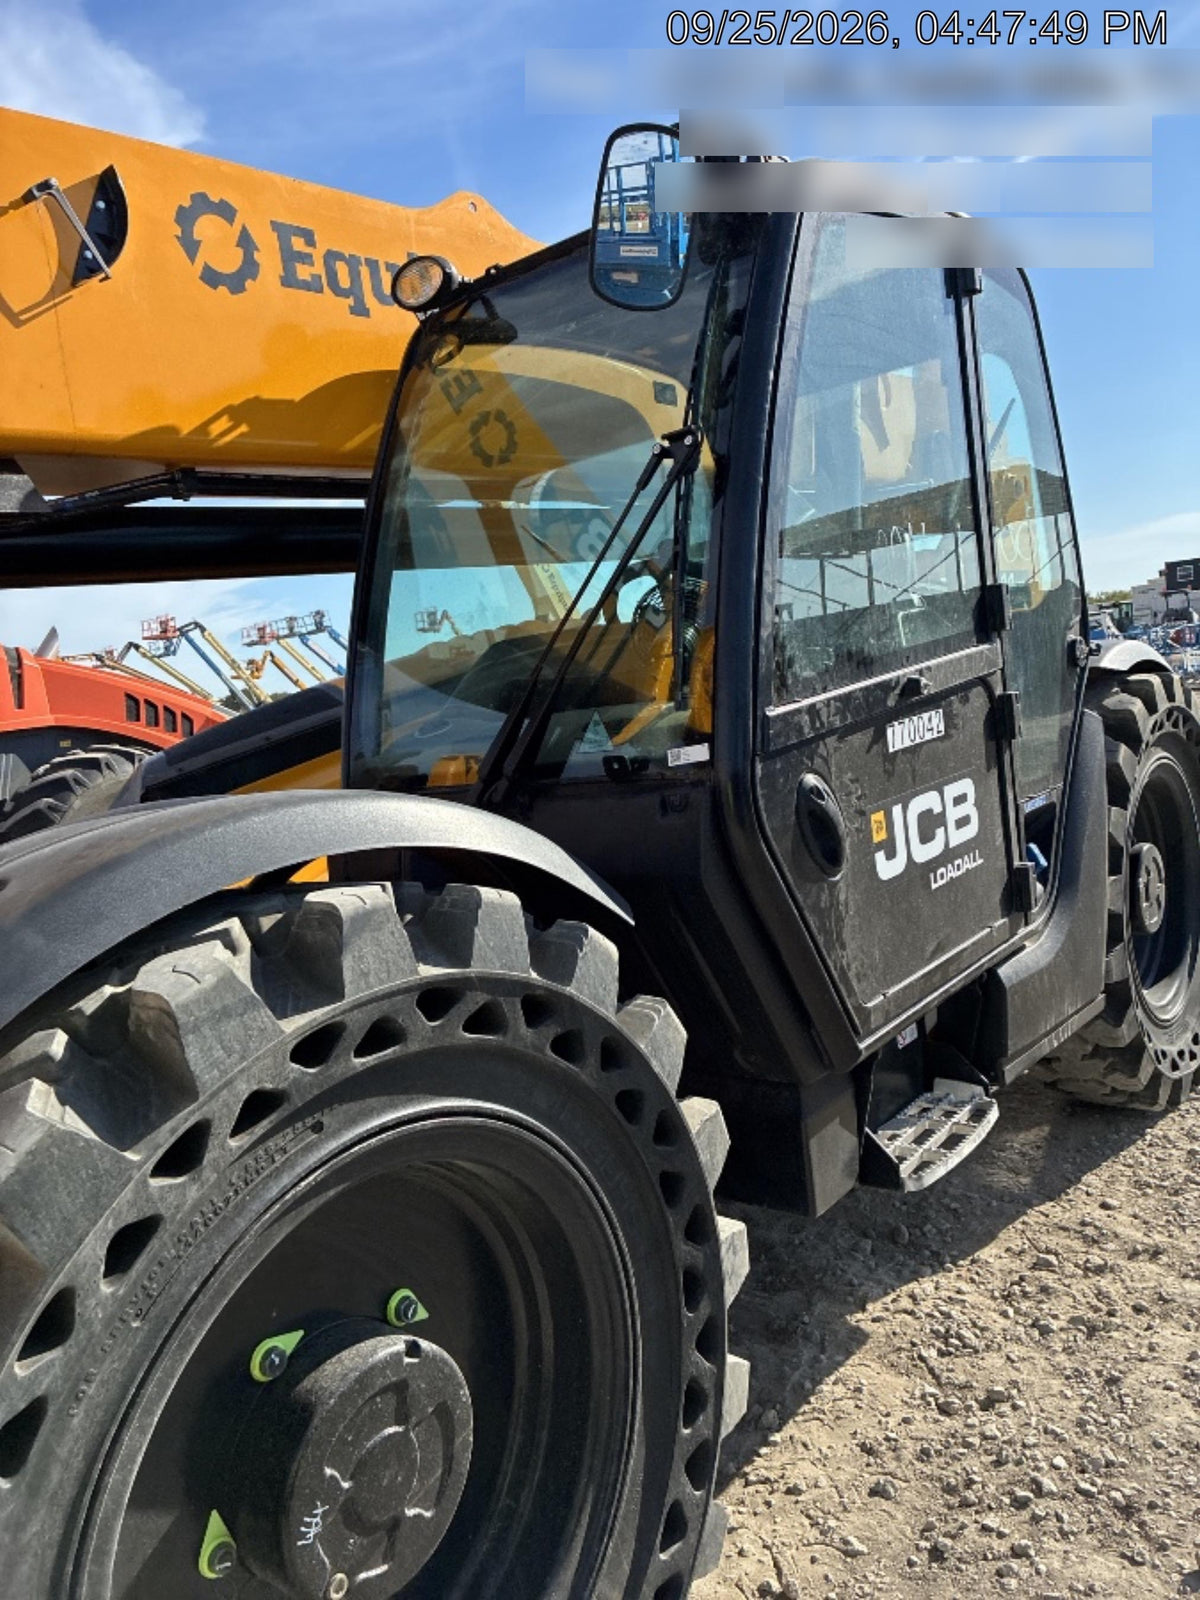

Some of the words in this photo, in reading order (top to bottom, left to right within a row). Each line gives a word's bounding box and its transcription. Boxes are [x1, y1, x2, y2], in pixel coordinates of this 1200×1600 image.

[270, 220, 410, 318] Equ
[888, 710, 943, 749] 770042
[875, 778, 979, 880] JCB
[930, 850, 984, 890] LOADALL
